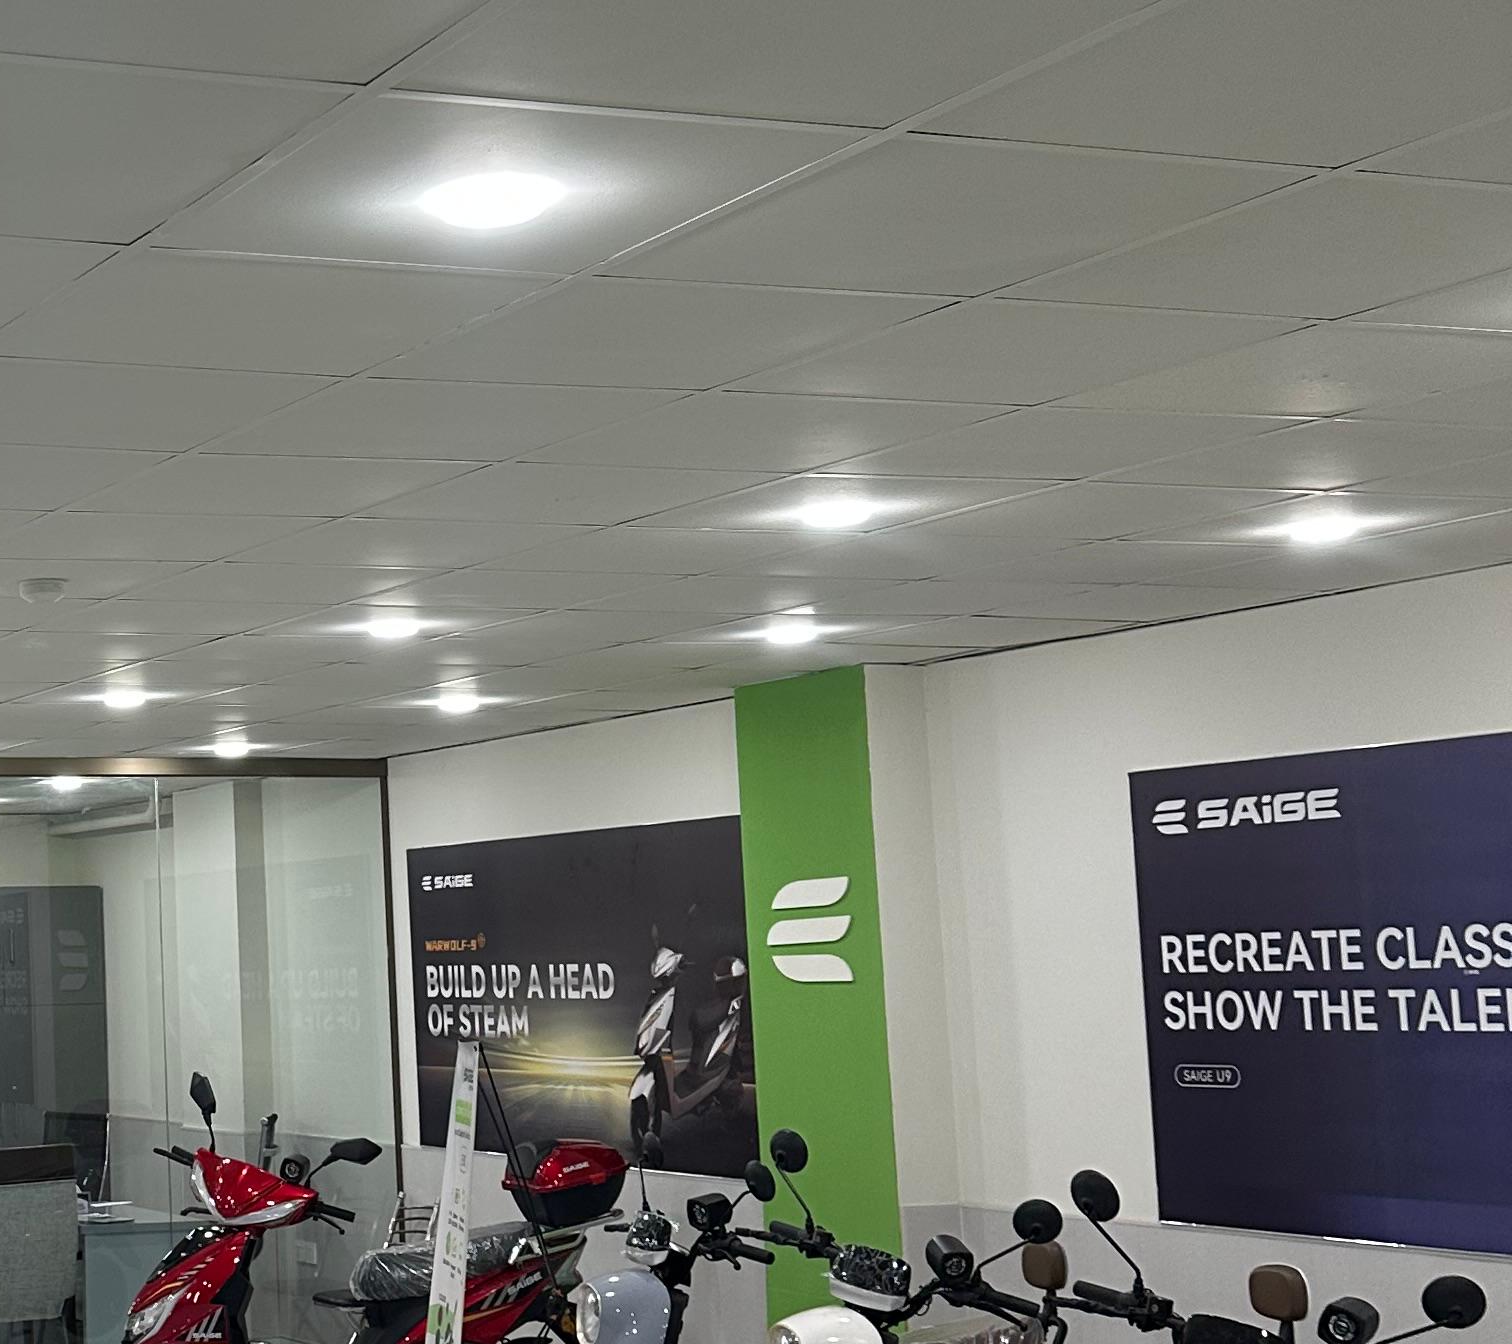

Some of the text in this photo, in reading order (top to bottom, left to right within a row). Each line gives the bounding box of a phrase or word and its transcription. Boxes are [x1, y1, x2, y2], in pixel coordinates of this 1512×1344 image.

[1159, 922, 1512, 974] RECREATE CLASS
[426, 963, 615, 999] BUILD UP A HEAD
[427, 1003, 529, 1038] OF STEAM
[1163, 989, 1283, 1031] SHOW
[1293, 989, 1378, 1031] THE
